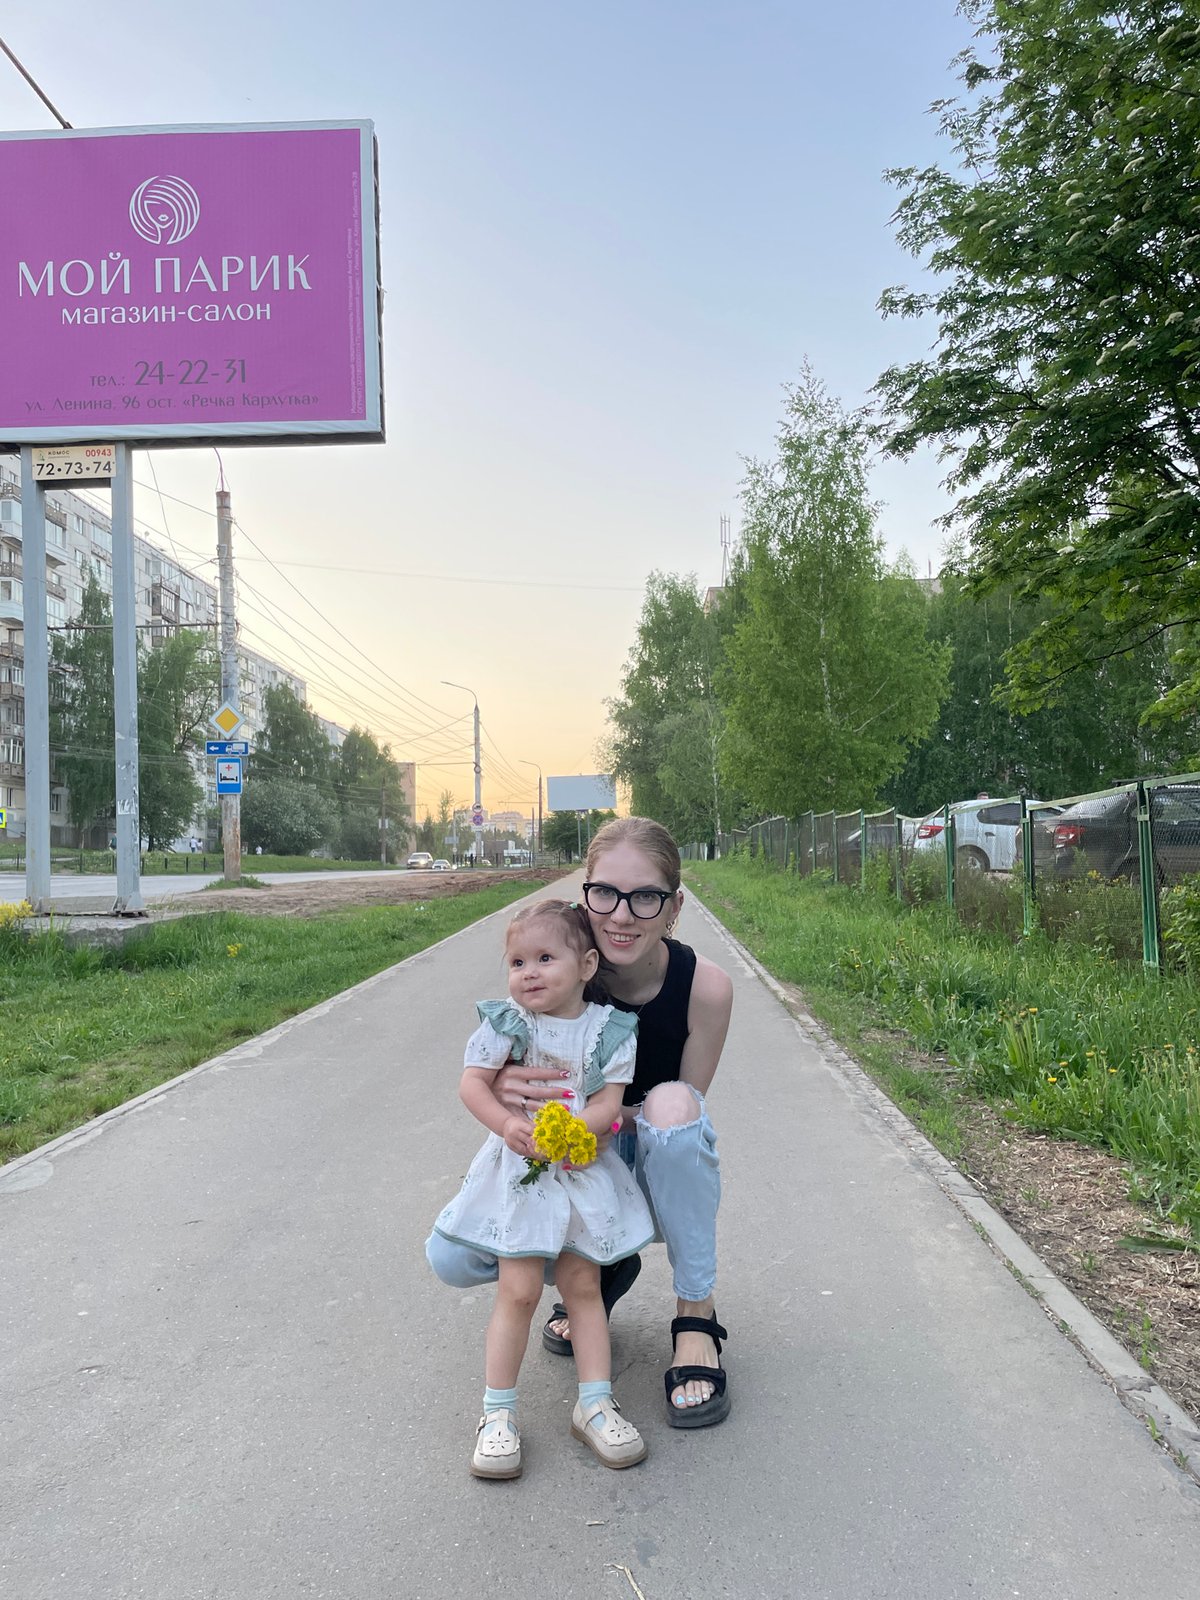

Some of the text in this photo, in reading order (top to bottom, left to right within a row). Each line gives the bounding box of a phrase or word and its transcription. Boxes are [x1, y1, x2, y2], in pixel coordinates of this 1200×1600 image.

[18, 251, 313, 297] МОЙ ПАРИК
[62, 303, 271, 325] магазин-салон
[90, 359, 247, 387] тел.: 24-22-31
[25, 401, 46, 413] ул.
[122, 395, 141, 409] 96
[146, 398, 176, 409] ост.
[85, 448, 112, 457] 00943
